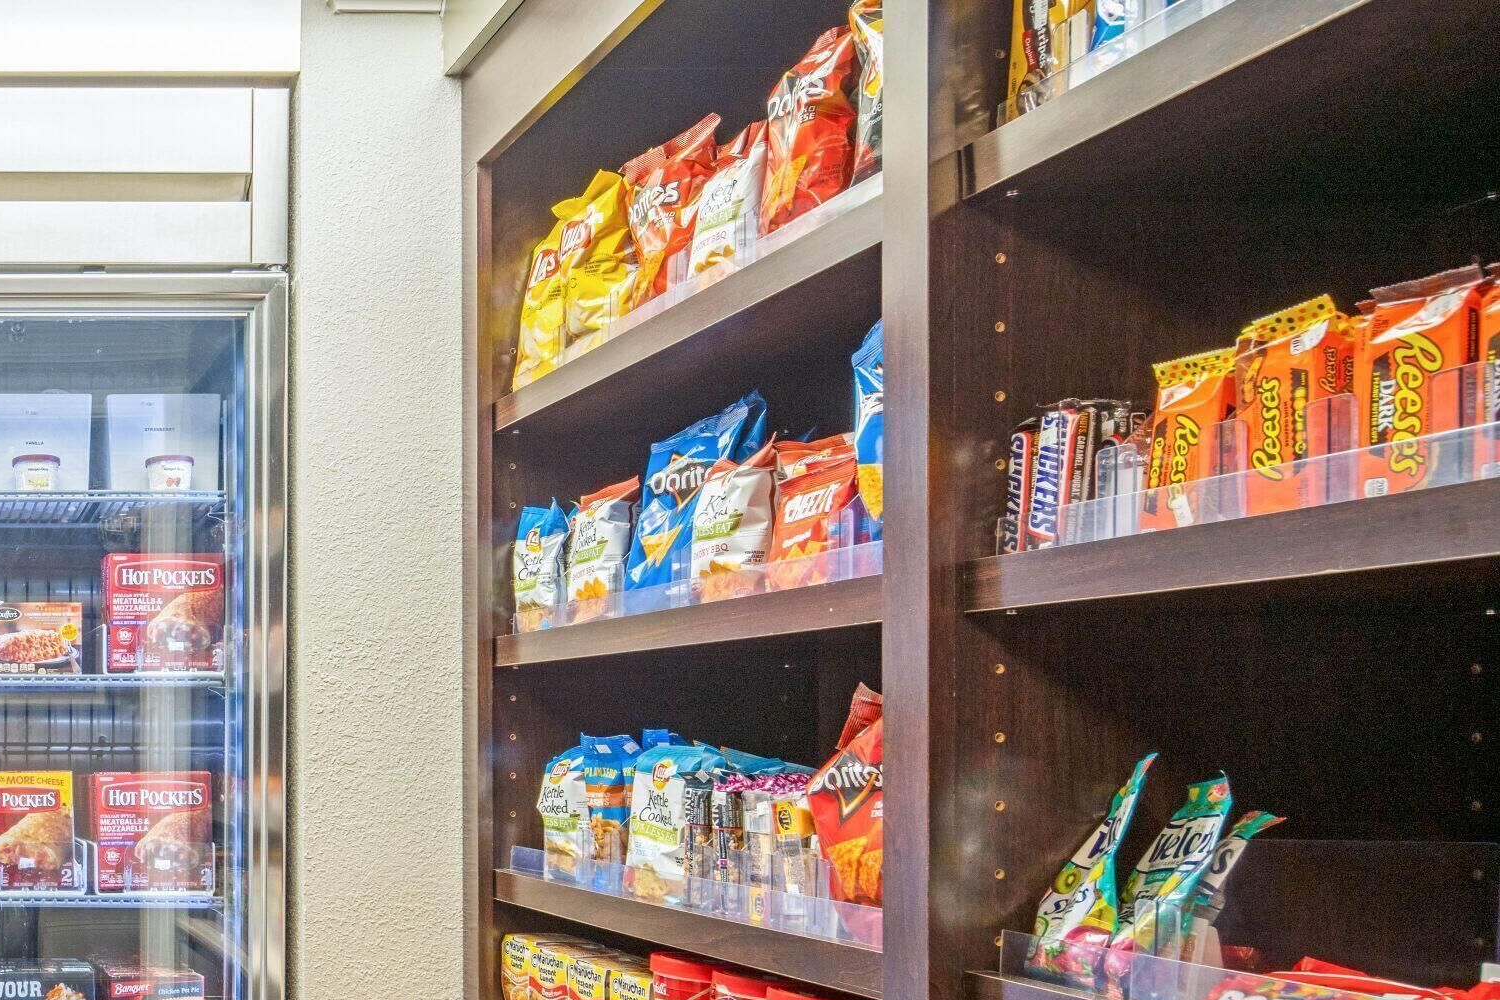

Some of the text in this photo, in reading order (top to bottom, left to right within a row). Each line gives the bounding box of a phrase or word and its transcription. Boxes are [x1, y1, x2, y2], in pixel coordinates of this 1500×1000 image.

[1025, 38, 1035, 64] Original
[1319, 347, 1337, 393] Reese's
[1378, 379, 1397, 432] DARK
[1390, 332, 1444, 477] Reese's
[1252, 377, 1283, 481] Reese's
[651, 468, 711, 494] Dorit
[716, 522, 733, 533] FAT
[6, 776, 35, 785] MORE
[37, 777, 64, 786] CHEESE
[542, 785, 564, 800] Kettle
[648, 790, 668, 807] Kettle
[559, 819, 574, 827] FAT
[639, 807, 672, 826] Cooked
[61, 869, 72, 882] 2
[537, 954, 563, 969] Maruchan
[540, 974, 555, 984] Lunch
[574, 964, 601, 983] Maruchan
[115, 983, 149, 994] Banquet
[577, 986, 593, 998] Lunch
[617, 978, 645, 997] Maruchan
